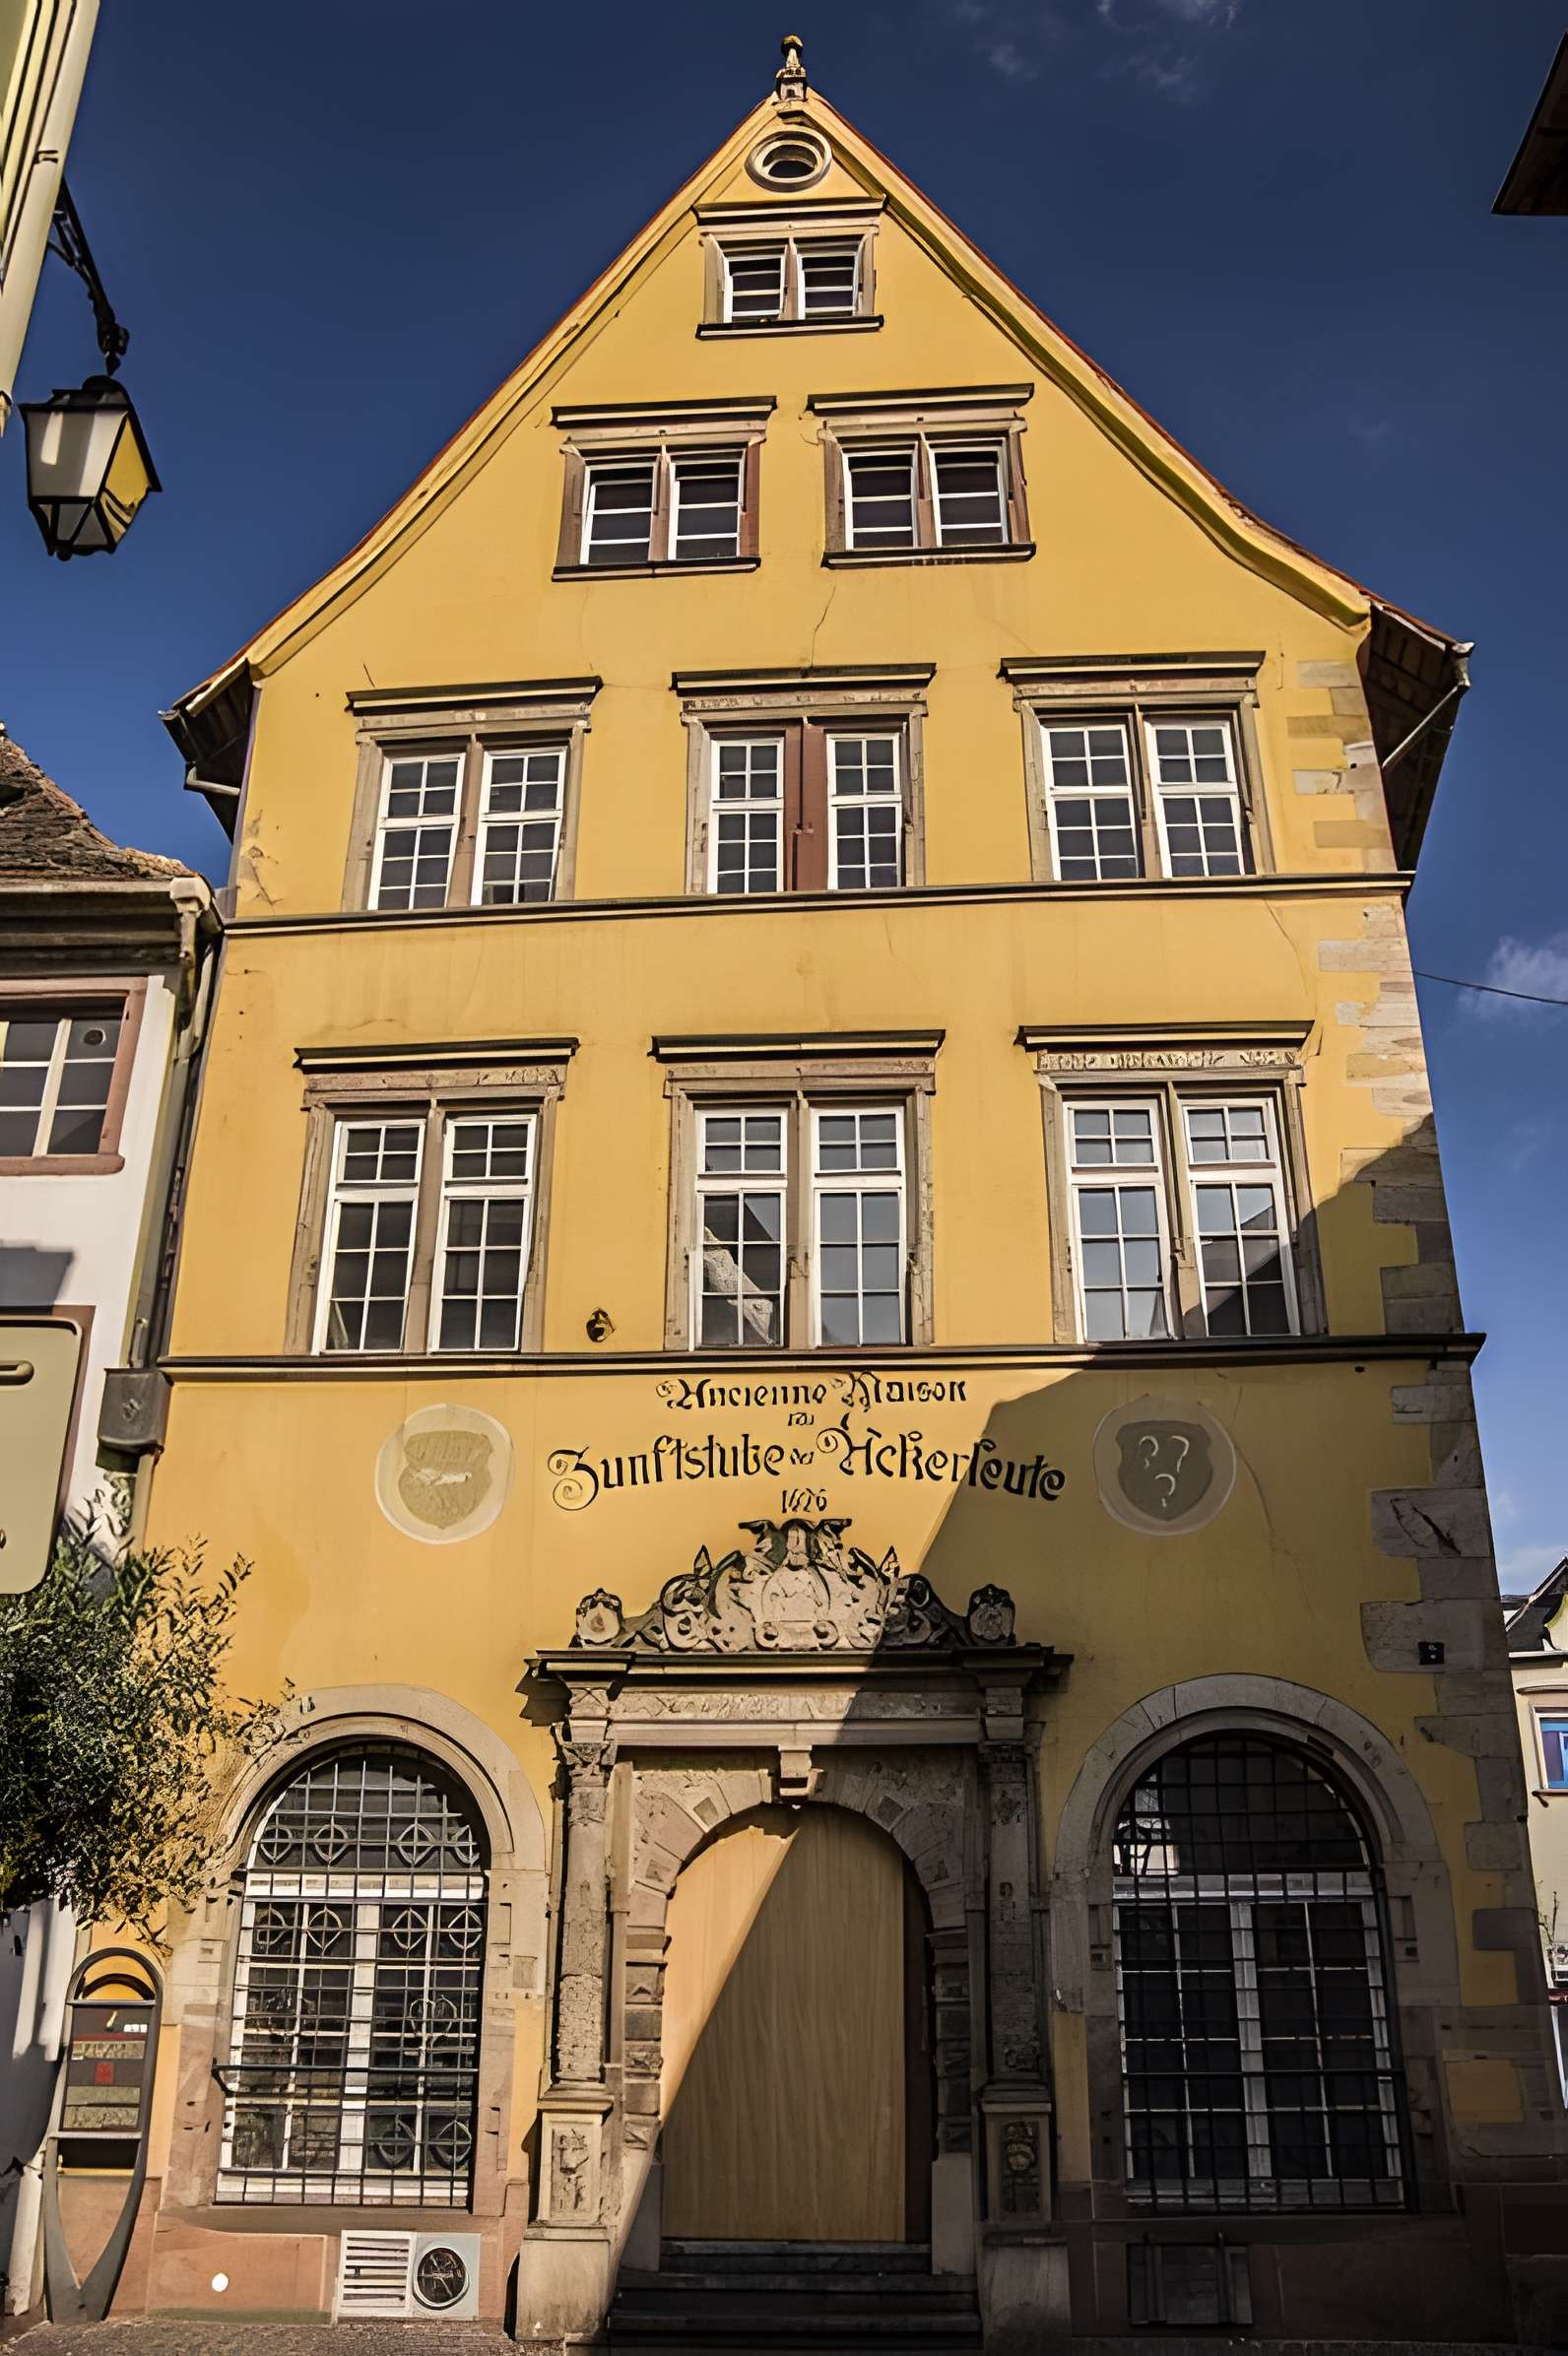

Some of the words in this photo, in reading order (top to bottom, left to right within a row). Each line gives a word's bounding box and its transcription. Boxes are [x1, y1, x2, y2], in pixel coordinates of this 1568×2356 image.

[656, 1379, 826, 1409] Ancienne
[830, 1371, 966, 1412] Maison
[548, 1433, 785, 1511] Zunftstube
[817, 1411, 1066, 1501] Ackerleute
